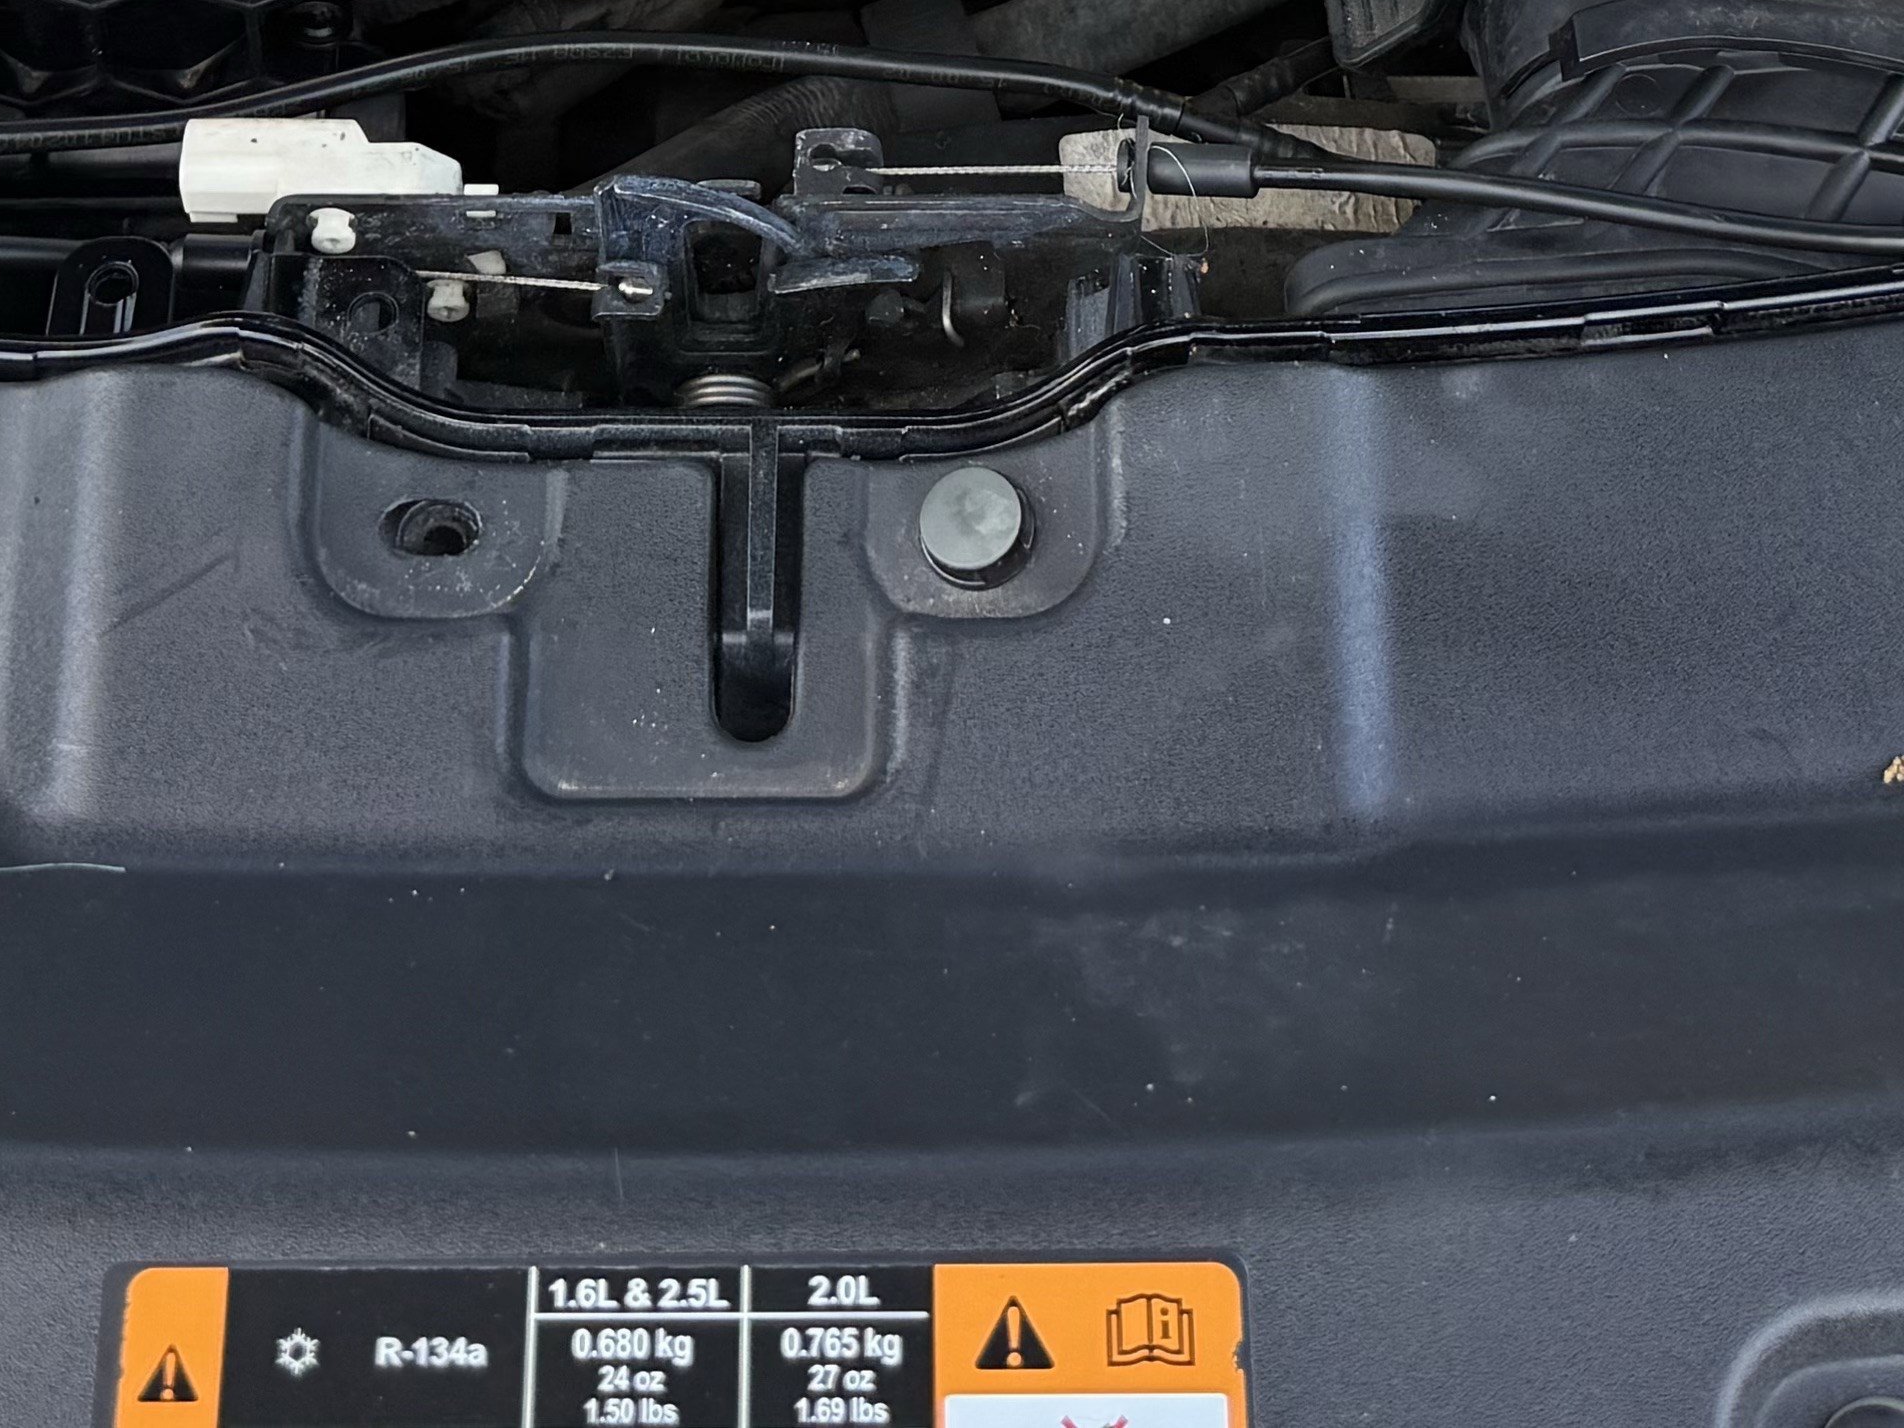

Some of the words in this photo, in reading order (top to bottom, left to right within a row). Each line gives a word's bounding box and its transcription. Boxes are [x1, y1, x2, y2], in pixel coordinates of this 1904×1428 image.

[549, 1278, 619, 1308] 1.6L
[624, 1278, 652, 1308] &
[658, 1278, 730, 1308] 2.5L
[808, 1275, 881, 1307] 2.0L
[374, 1337, 488, 1368] R-134a
[571, 1327, 650, 1360] 0.680
[655, 1327, 694, 1368] kg
[781, 1327, 859, 1360] 0.765
[863, 1327, 904, 1366] kg
[597, 1366, 629, 1392] 24
[632, 1371, 665, 1392] oz
[807, 1366, 838, 1392] 27
[841, 1371, 876, 1392] oz
[583, 1398, 636, 1424] 1.50
[640, 1398, 679, 1424] lbs
[795, 1398, 845, 1424] 1.69
[851, 1398, 890, 1424] lbs
